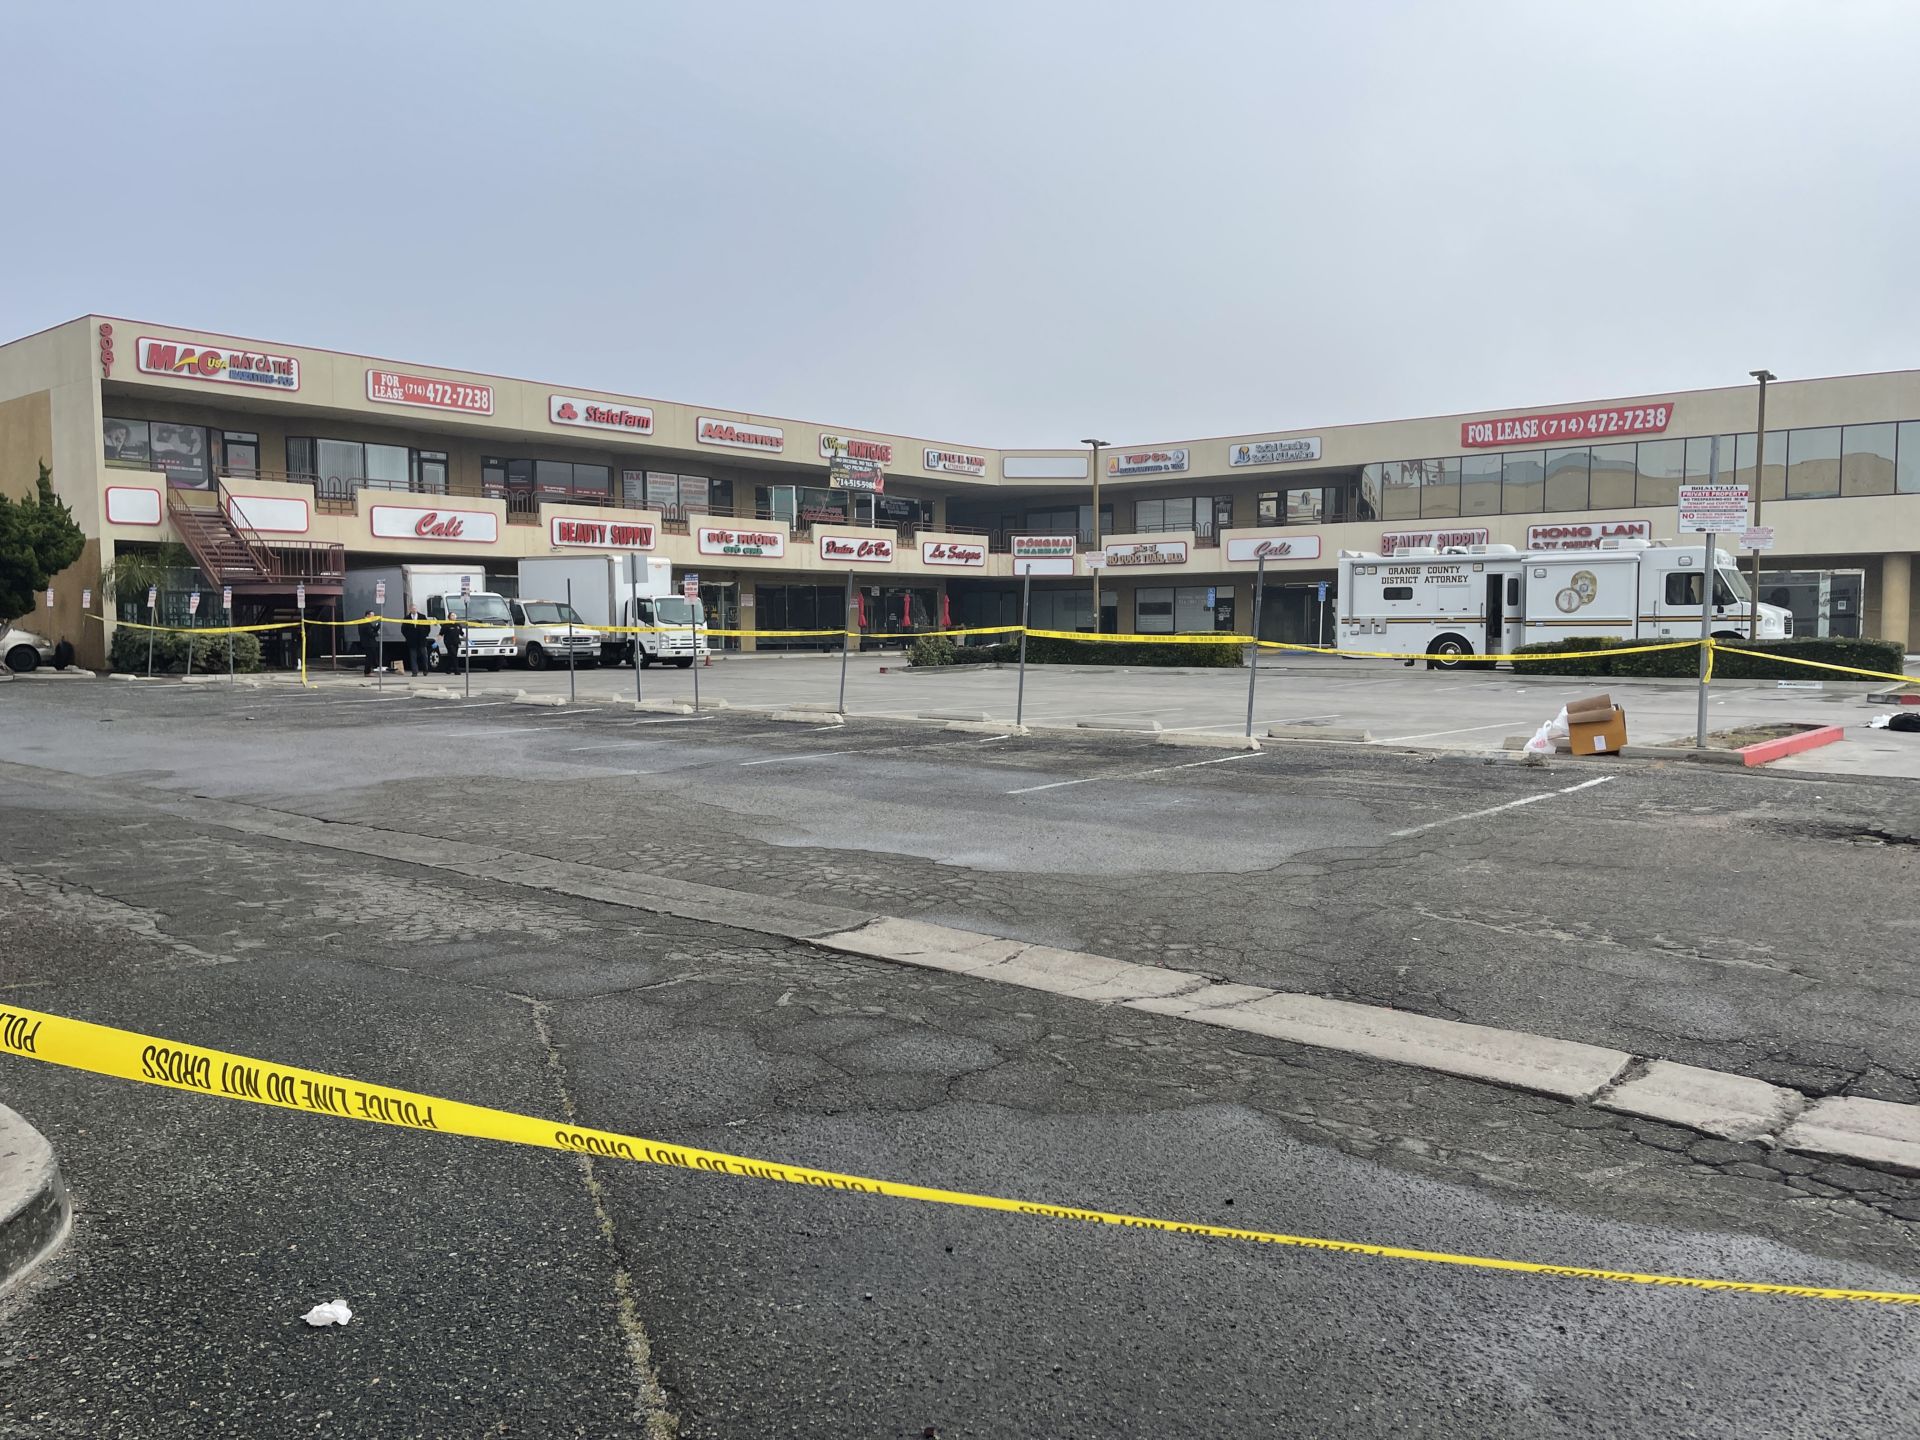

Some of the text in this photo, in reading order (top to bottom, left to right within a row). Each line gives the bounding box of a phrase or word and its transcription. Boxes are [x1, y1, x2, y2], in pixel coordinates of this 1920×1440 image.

[100, 323, 114, 378] 9081
[381, 374, 400, 387] FOR
[374, 385, 405, 400] LEASE
[405, 383, 489, 409] (714) 472-7238
[702, 423, 737, 441] AAA
[1467, 407, 1666, 443] FOR LEASE (714) 472-7238
[848, 440, 892, 462] MORTGAGE
[415, 512, 464, 537] Cali
[559, 522, 653, 546] BEAUTY SUPPLY
[1532, 524, 1644, 539] HONG LAN
[1382, 531, 1486, 553] BEAUTY SUPPLY
[1381, 575, 1469, 585] DISTRICT ATTORNEY
[1388, 565, 1461, 575] ORANGE COUNTY
[0, 1012, 42, 1053] POL
[142, 1045, 439, 1129] POLICE LINE DO NOT CROSS
